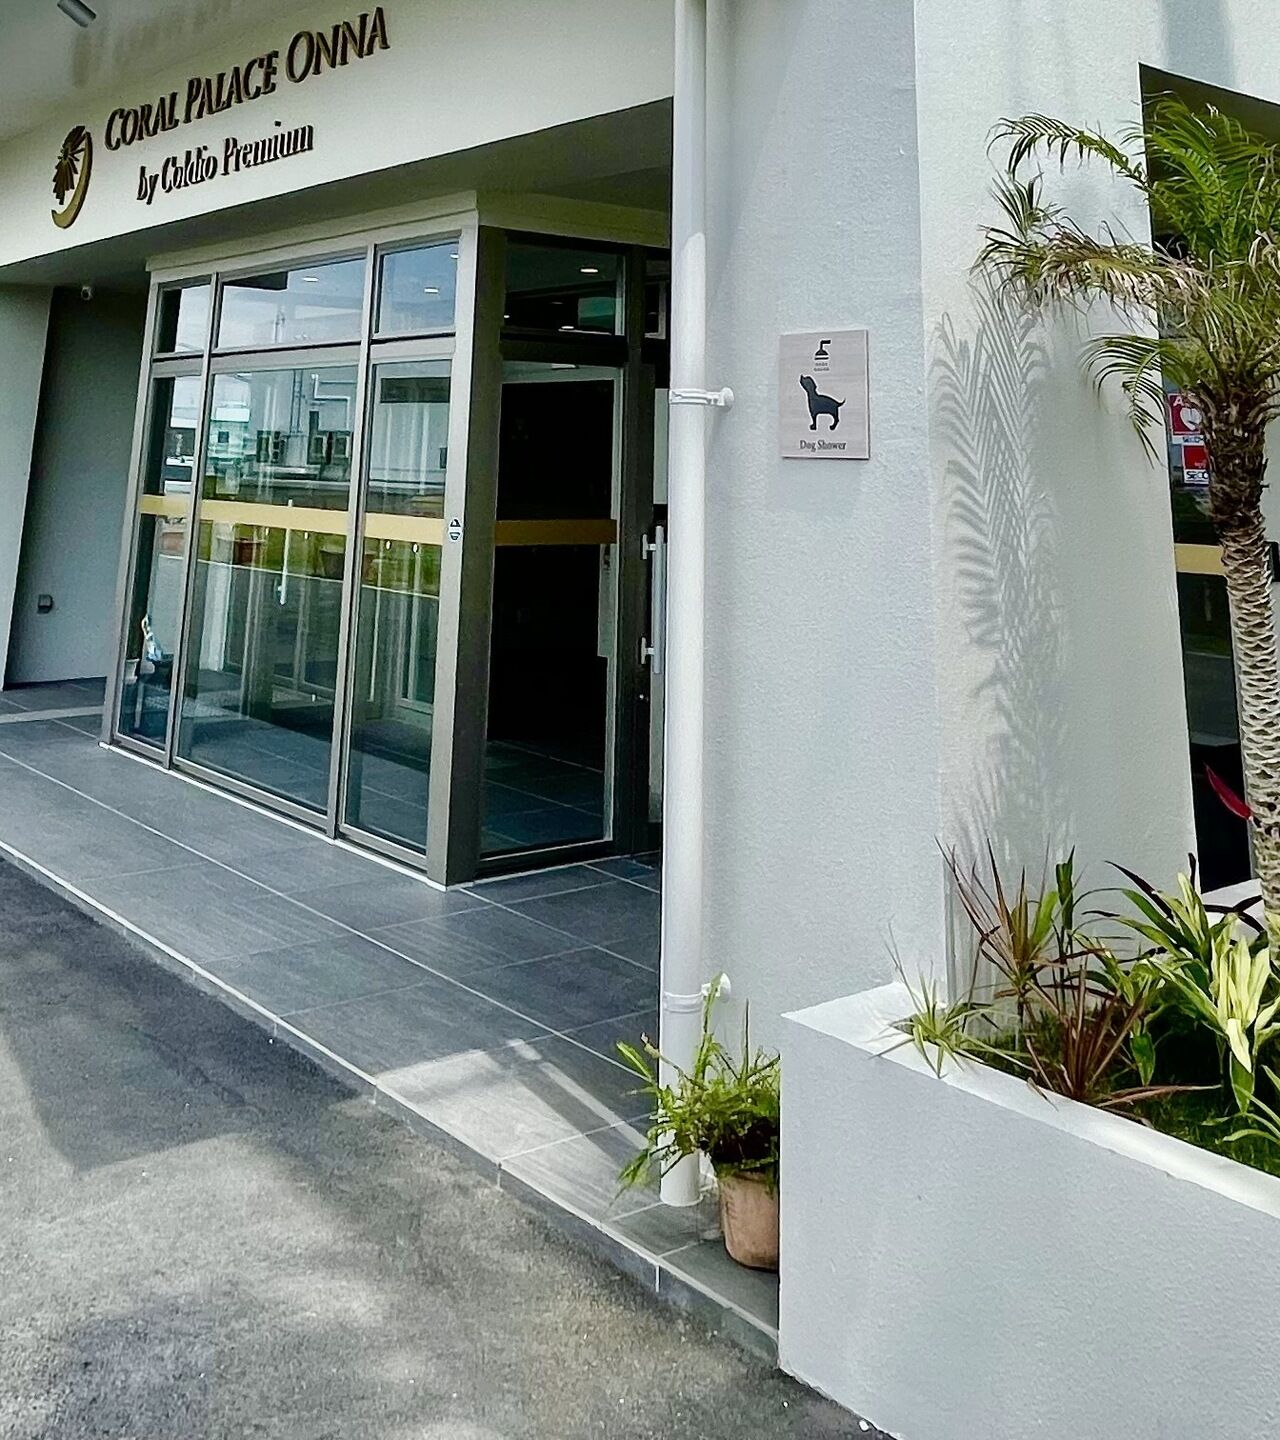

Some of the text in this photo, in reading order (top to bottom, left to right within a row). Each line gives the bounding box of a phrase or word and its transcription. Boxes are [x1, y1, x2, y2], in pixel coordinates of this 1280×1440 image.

[105, 6, 391, 150] CORAL PALACE ONNA
[137, 121, 314, 205] by Coldio Premium
[800, 439, 847, 452] Dog Shower
